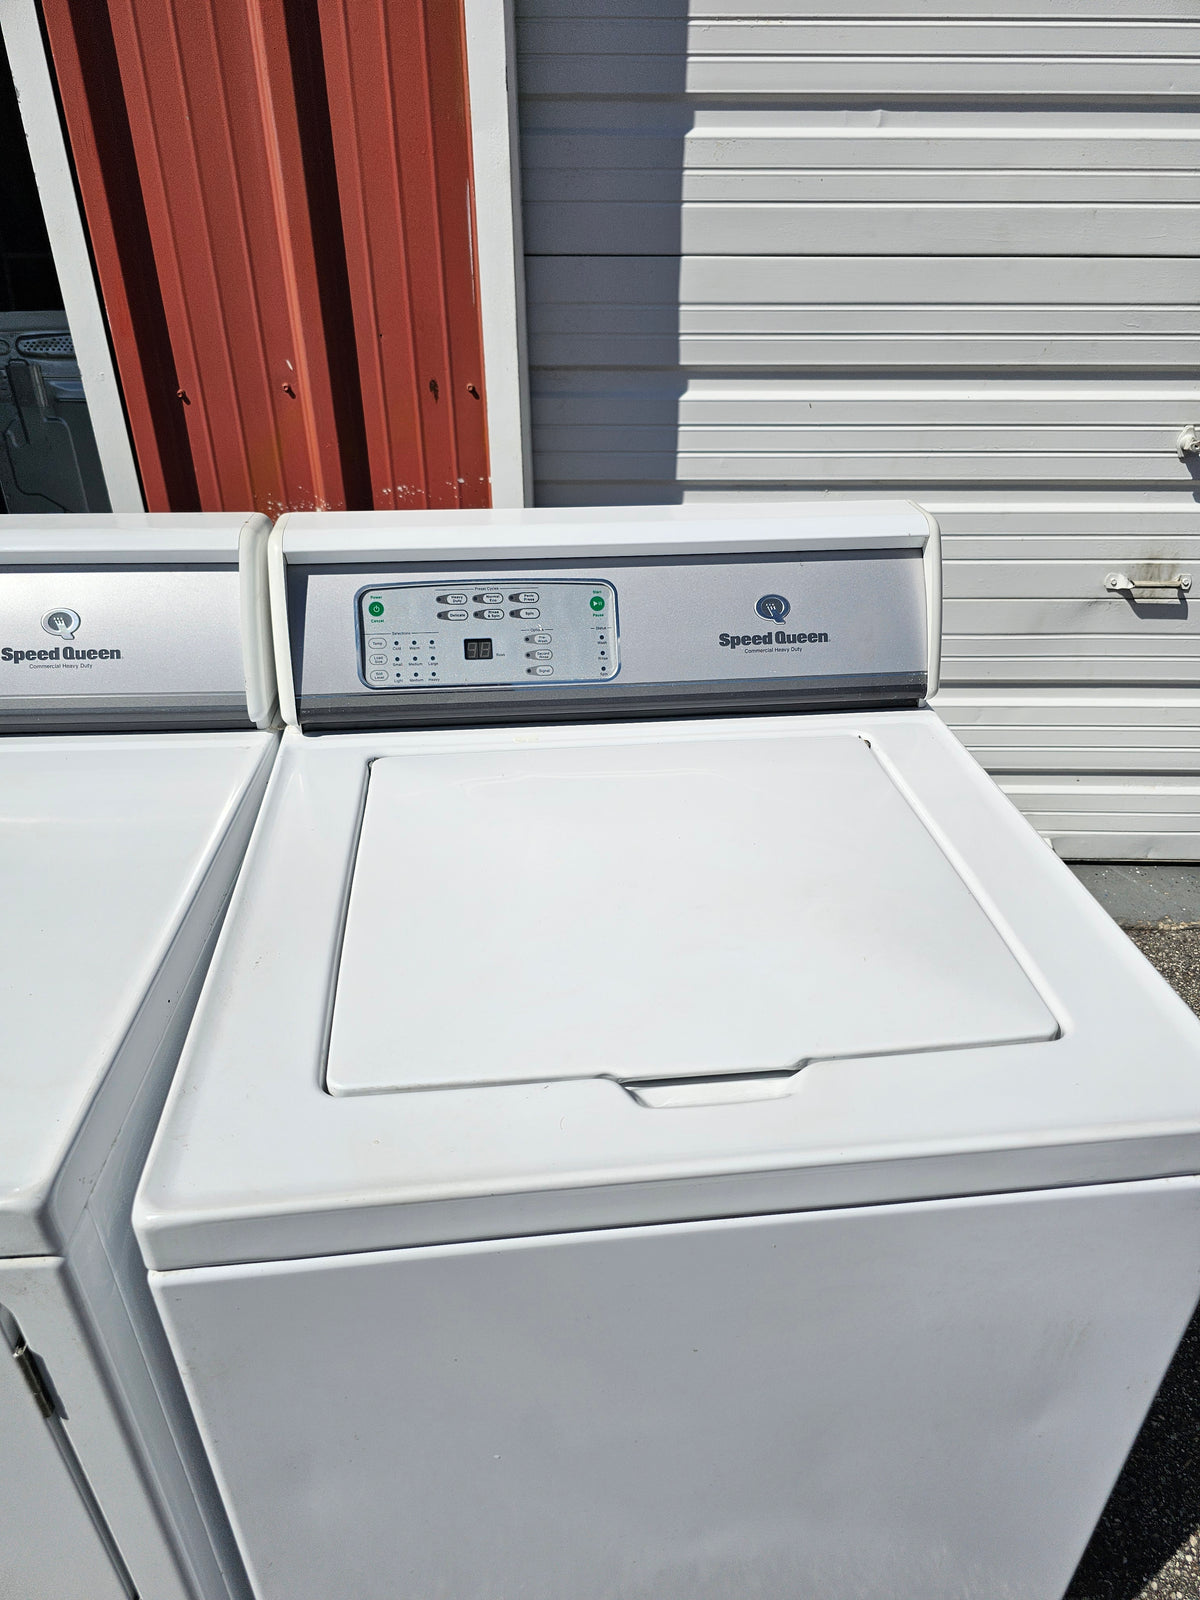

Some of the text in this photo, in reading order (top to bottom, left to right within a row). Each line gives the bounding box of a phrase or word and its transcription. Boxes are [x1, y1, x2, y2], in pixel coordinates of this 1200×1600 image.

[719, 631, 828, 649] Speed Queen
[1, 647, 121, 664] Speed Queen
